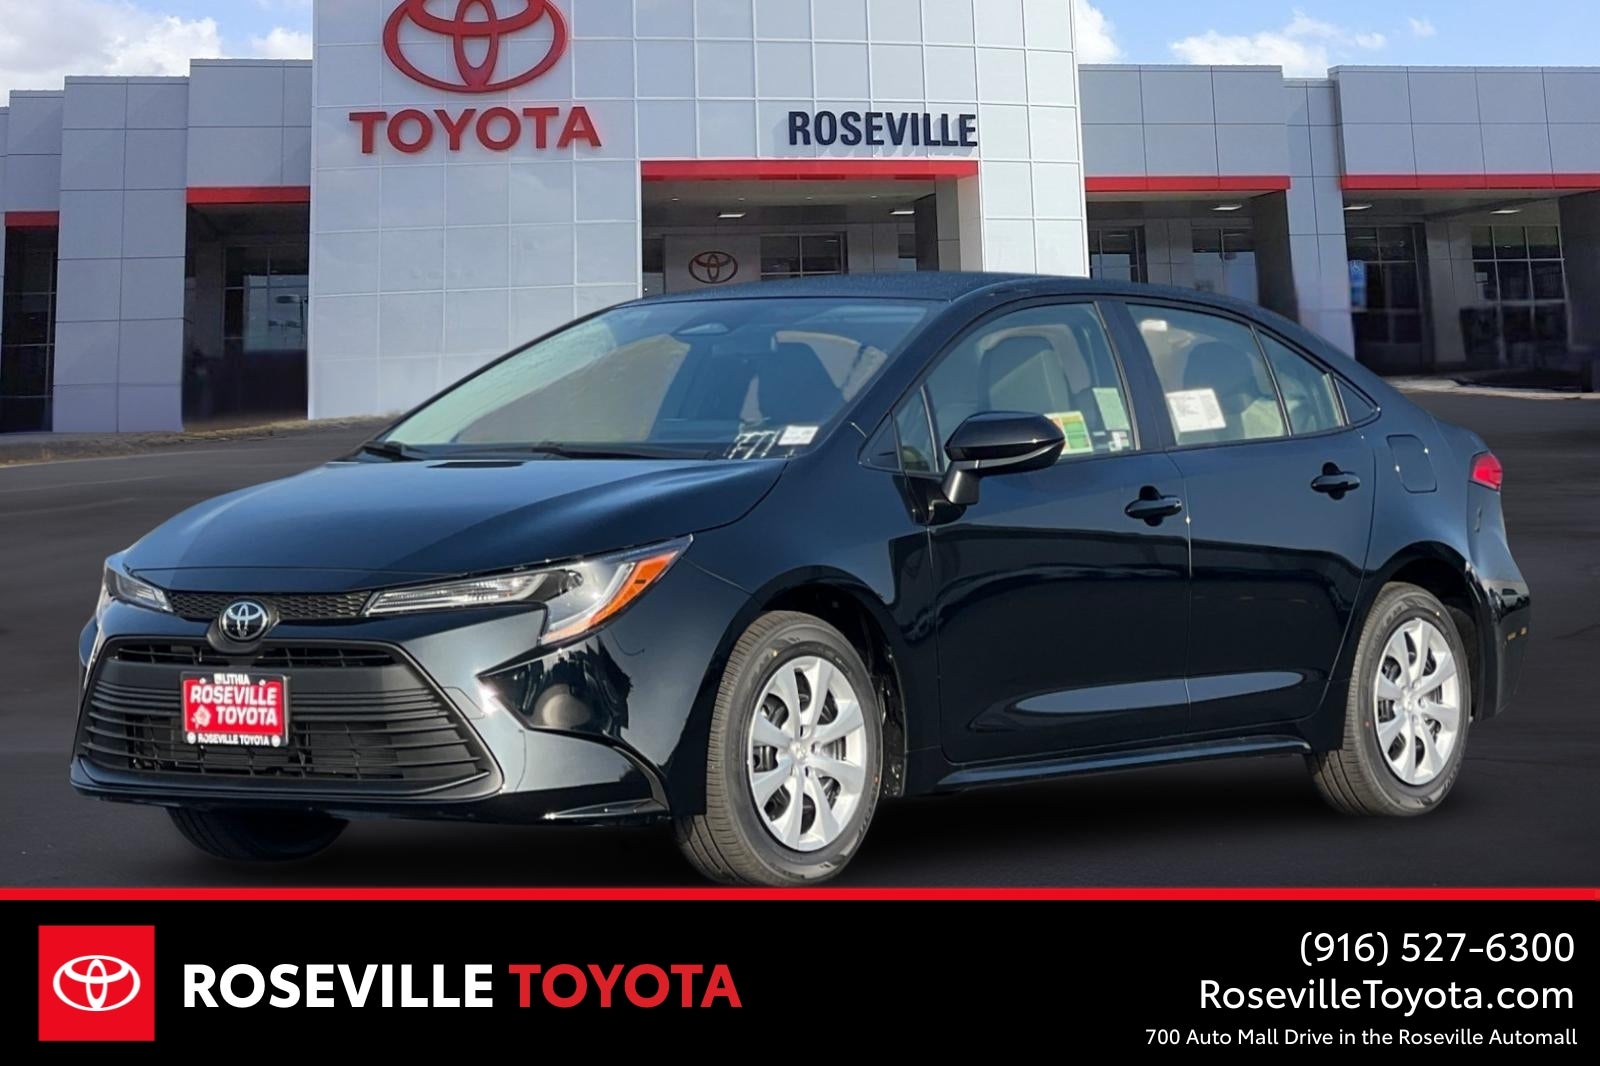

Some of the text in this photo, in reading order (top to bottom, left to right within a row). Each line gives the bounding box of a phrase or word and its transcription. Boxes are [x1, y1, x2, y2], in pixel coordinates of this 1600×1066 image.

[349, 105, 602, 154] TOYOTA
[788, 110, 979, 148] ROSEVILLE
[223, 673, 251, 686] LITHIA
[190, 685, 278, 706] ROSEVILLE
[215, 705, 278, 726] TOYOTA
[198, 733, 270, 746] ROSEVILLE TOYOTA
